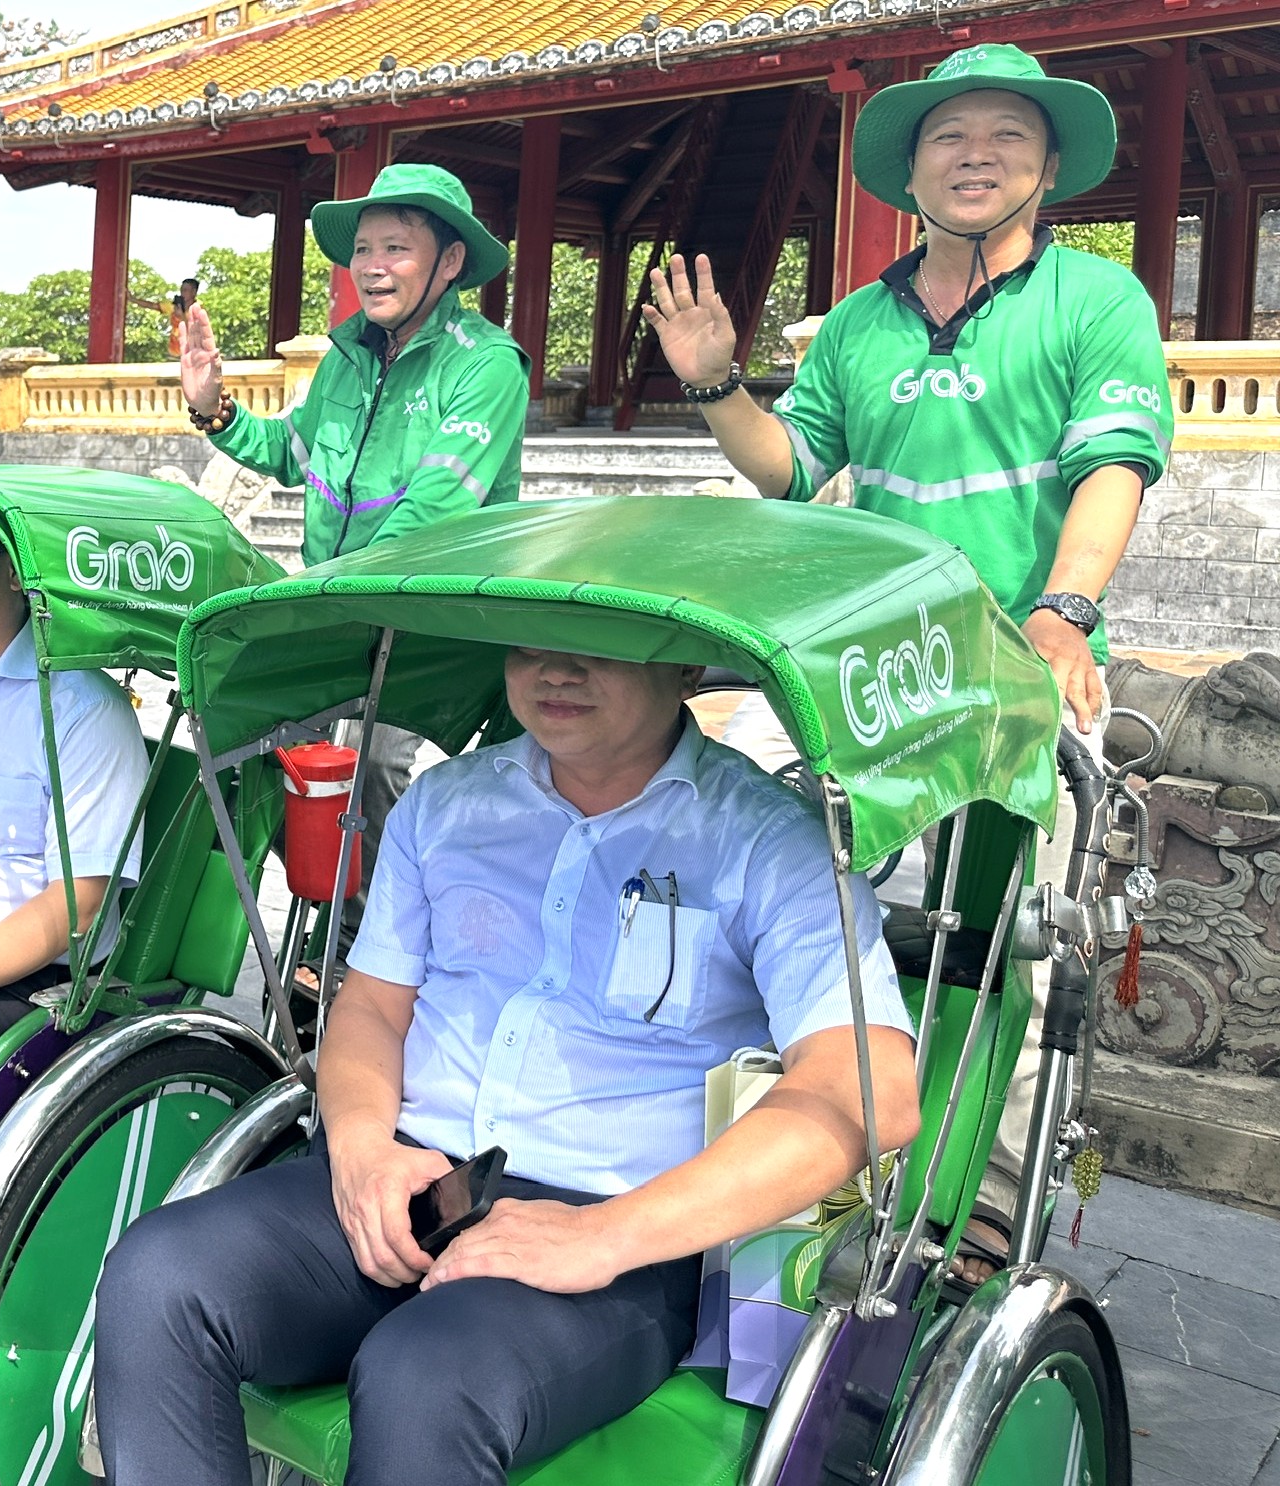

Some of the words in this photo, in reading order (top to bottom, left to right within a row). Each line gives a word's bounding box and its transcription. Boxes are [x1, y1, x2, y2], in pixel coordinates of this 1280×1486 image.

[890, 364, 986, 404] Grab
[1098, 379, 1161, 415] Grab
[440, 415, 492, 445] Grab
[65, 524, 195, 592] Grab
[839, 602, 954, 747] Grab
